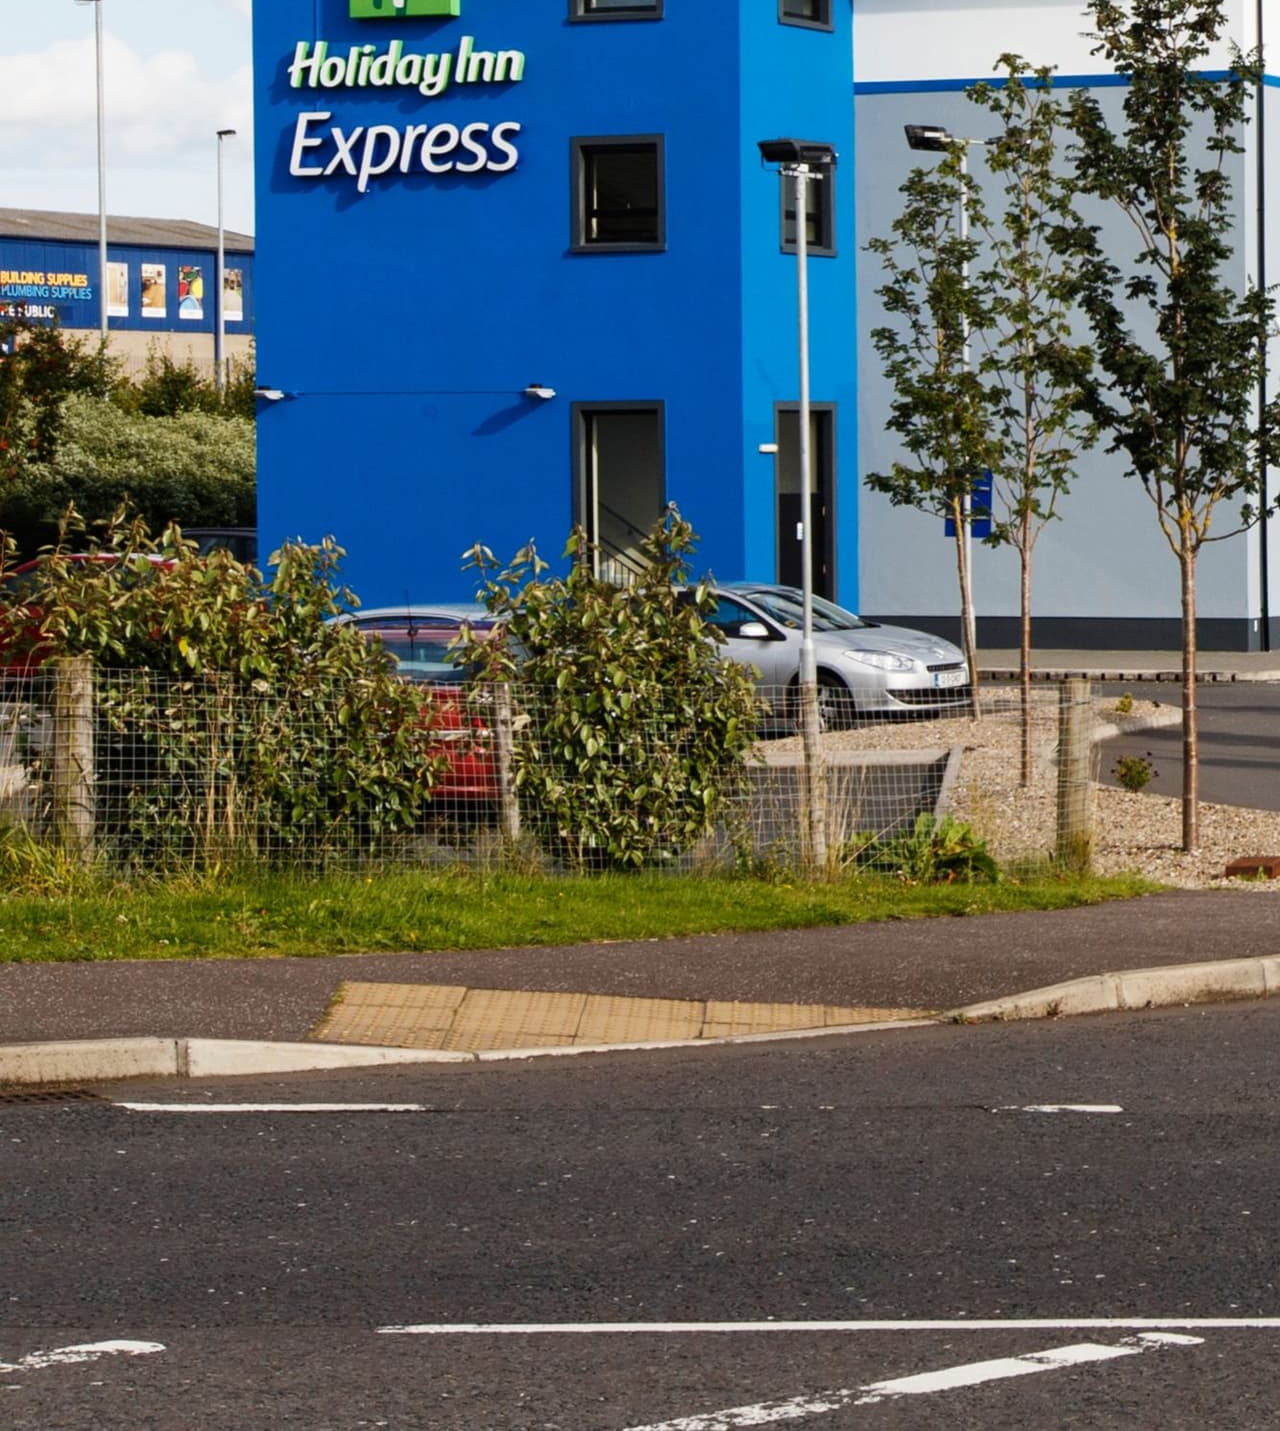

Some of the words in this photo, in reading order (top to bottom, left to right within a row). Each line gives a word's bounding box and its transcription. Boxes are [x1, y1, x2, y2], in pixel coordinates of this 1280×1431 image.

[288, 39, 453, 97] Holiday
[455, 35, 526, 84] Inn
[289, 111, 521, 193] Express
[0, 270, 45, 285] BUILDING
[47, 273, 88, 287] SUPPLIES
[1, 285, 49, 297] PLUMBING
[51, 286, 93, 300] SUPPLIES
